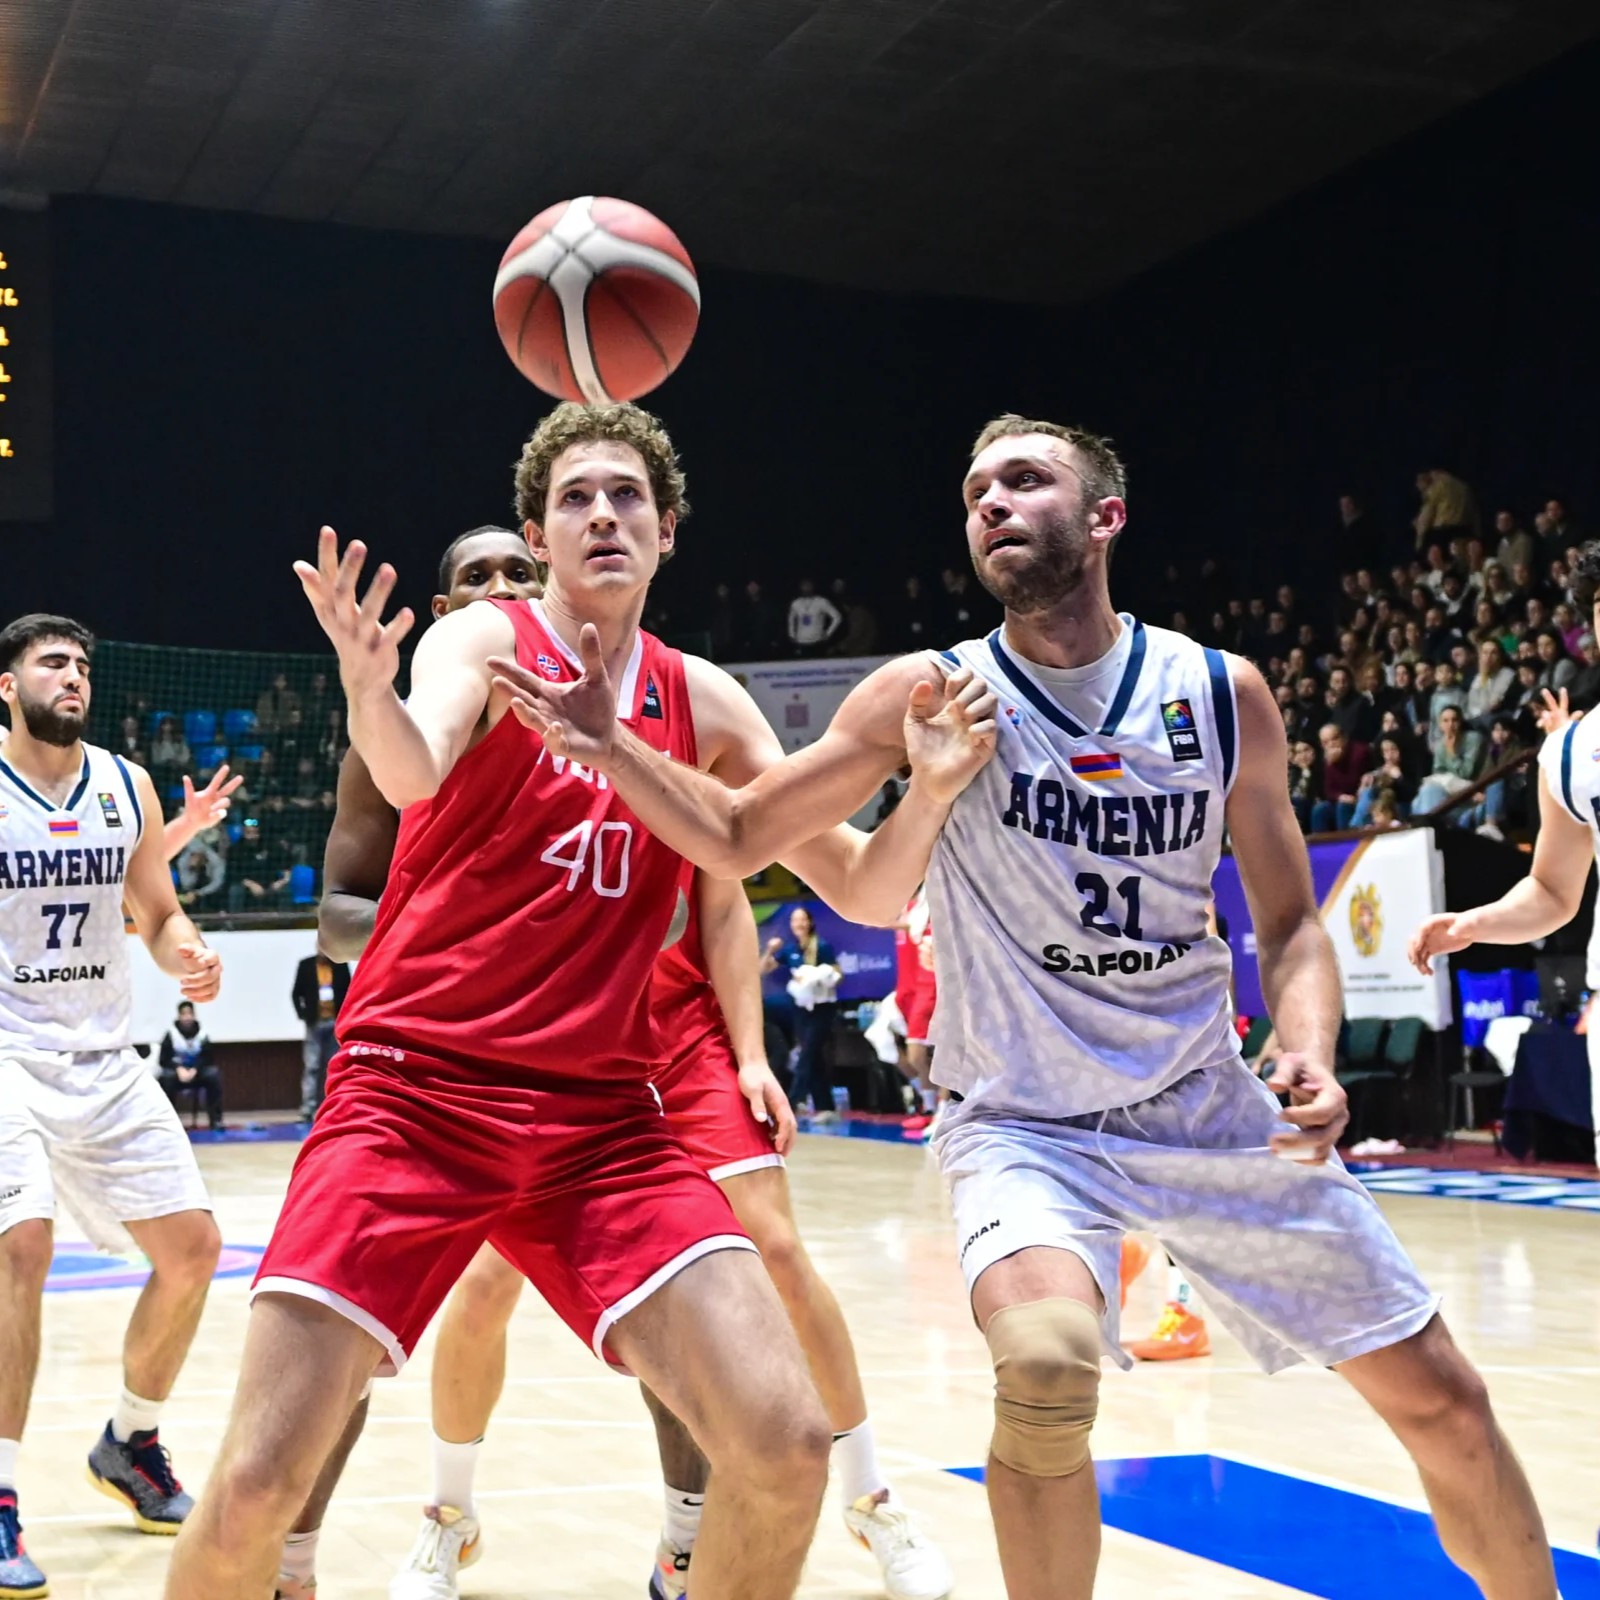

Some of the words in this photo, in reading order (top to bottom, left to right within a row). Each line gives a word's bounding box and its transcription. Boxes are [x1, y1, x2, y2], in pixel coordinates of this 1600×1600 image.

[1002, 771, 1210, 857] ARMENIA
[0, 846, 125, 889] ARMENIA
[540, 820, 632, 898] 40
[41, 902, 90, 949] 77
[1074, 872, 1143, 941] 21
[14, 964, 105, 984] SAFOIAN
